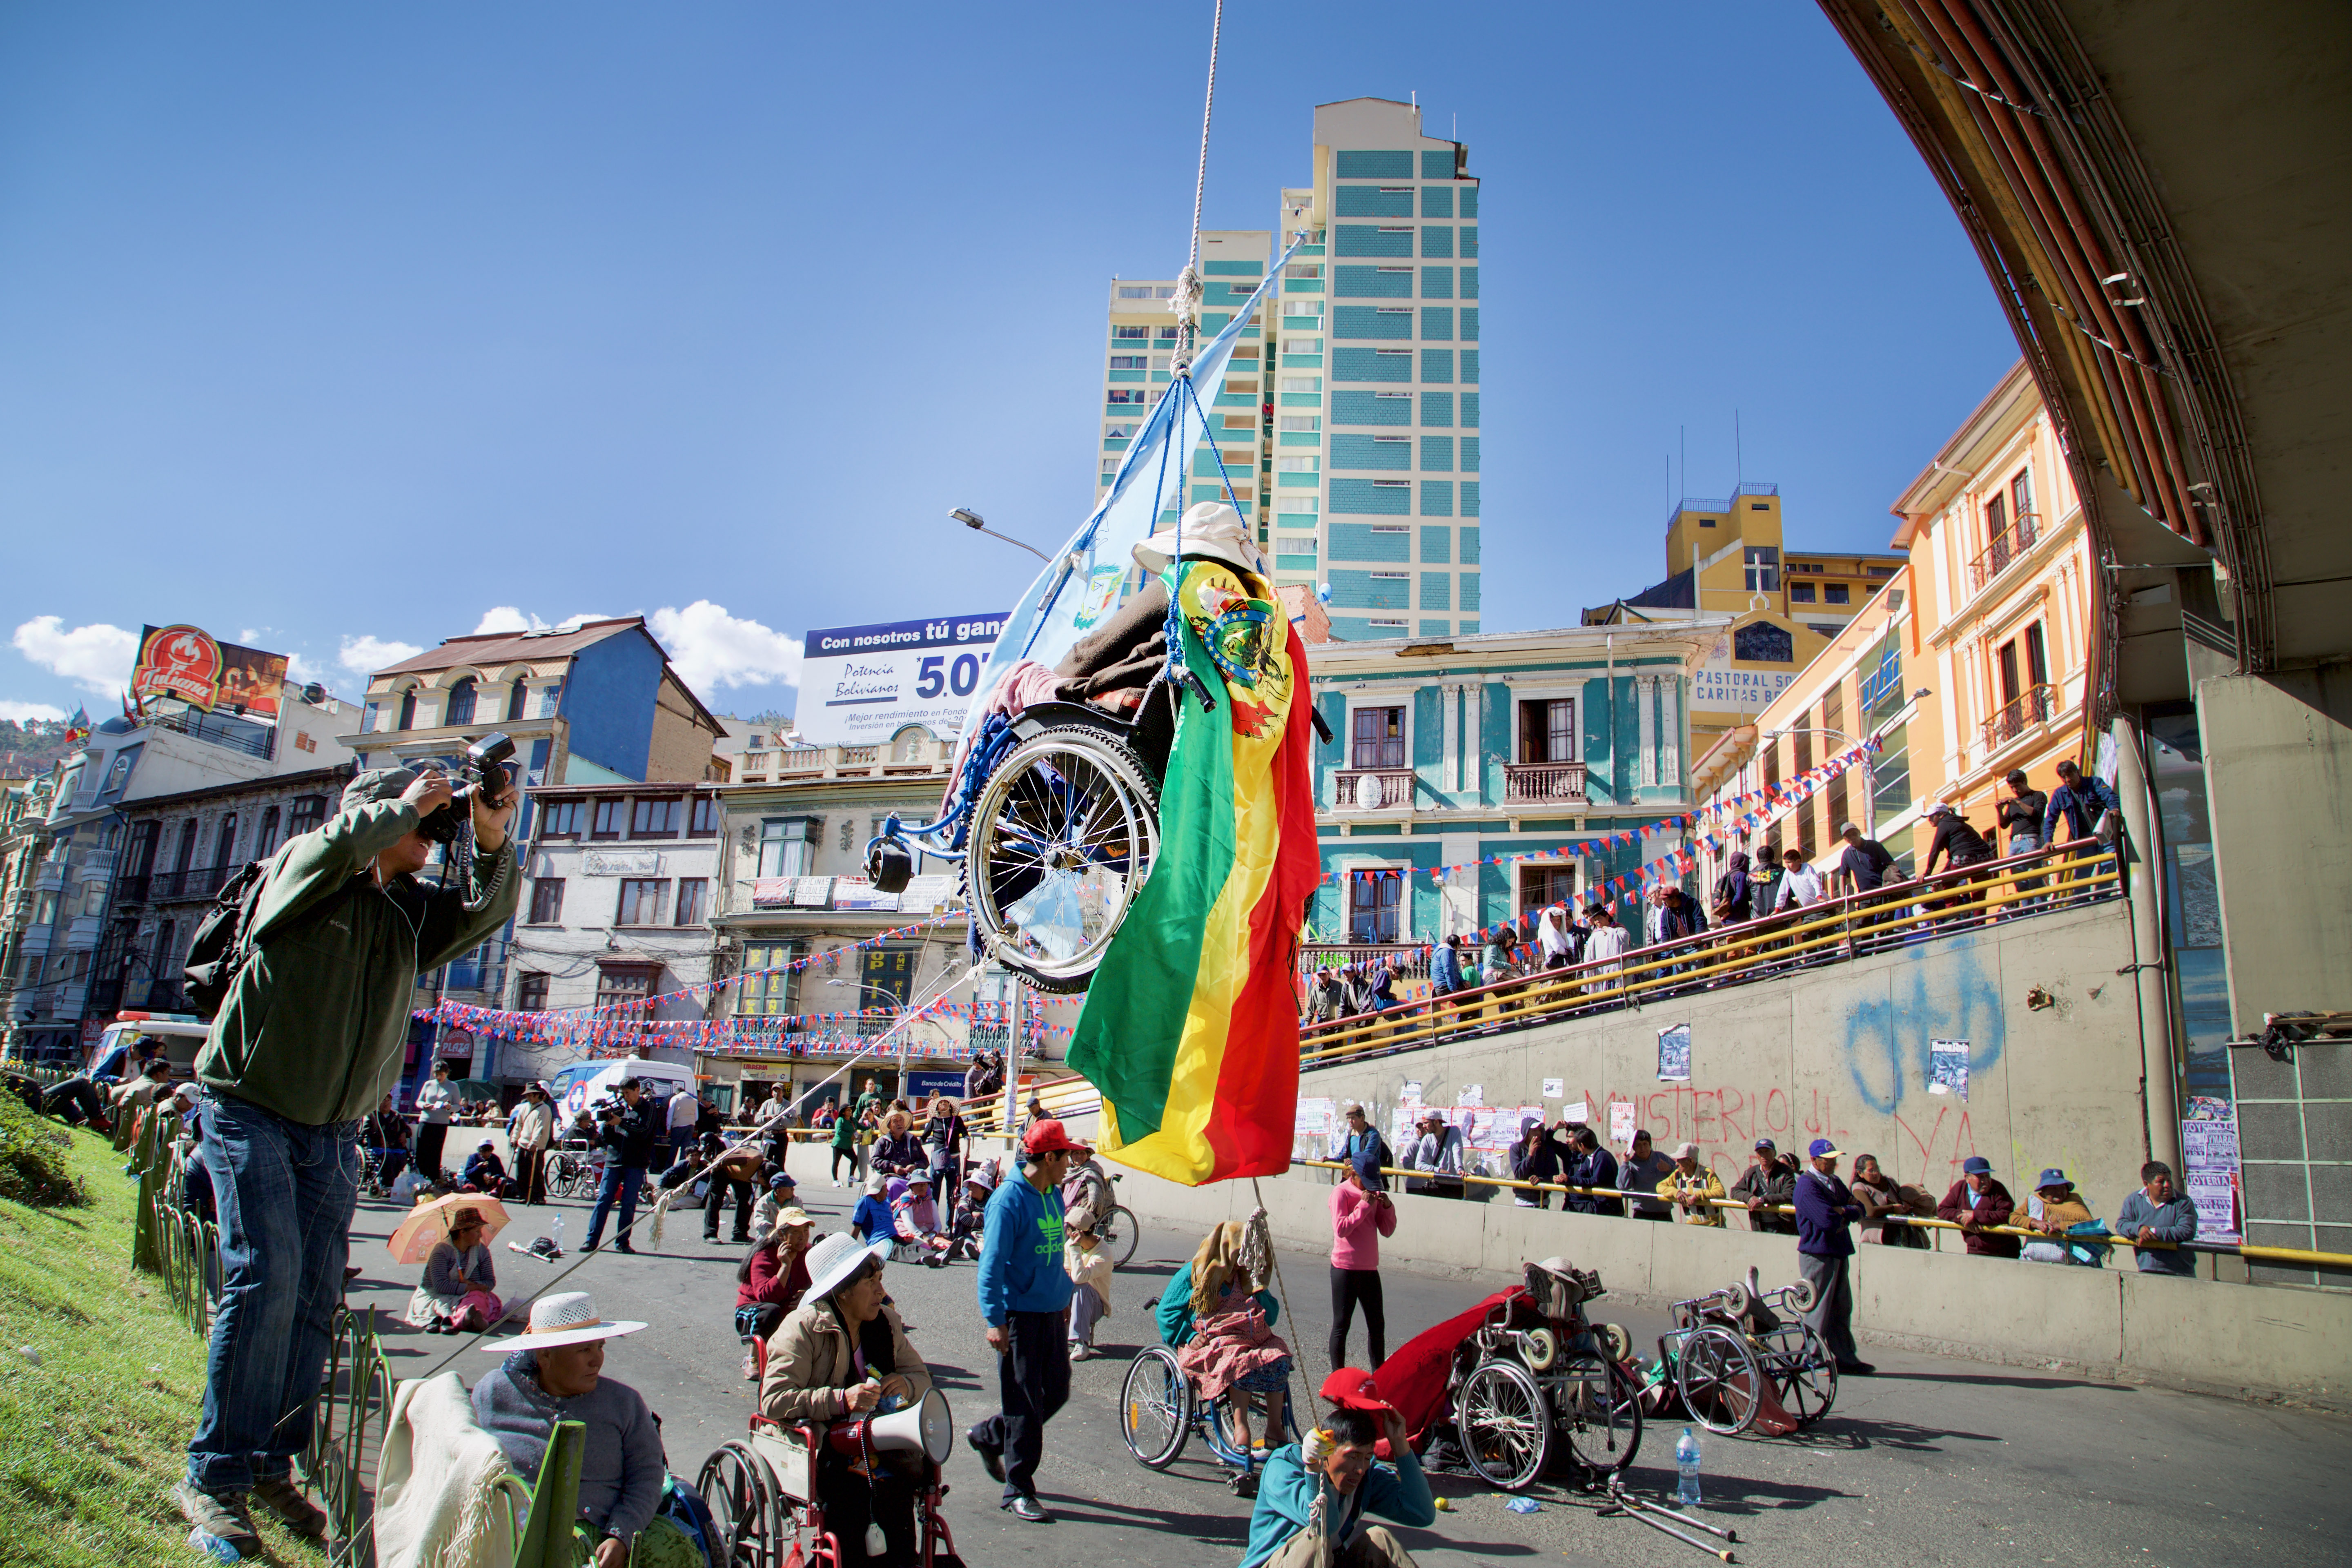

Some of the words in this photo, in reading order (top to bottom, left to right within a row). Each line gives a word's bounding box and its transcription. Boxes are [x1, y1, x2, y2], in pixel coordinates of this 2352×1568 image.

[821, 637, 850, 649] Con
[854, 631, 921, 646] nosotros
[926, 620, 949, 640] tú
[844, 663, 894, 679] Potencia
[136, 667, 212, 698] Juliana
[1697, 671, 1768, 687] PASTORAL
[1776, 675, 1797, 688] SO
[835, 681, 899, 697] Bolivianos
[1697, 687, 1757, 702] CARITAS
[844, 714, 873, 724] ¡Mejor
[875, 710, 928, 720] rendimiento
[849, 722, 882, 730] Inversión
[447, 1030, 469, 1042] HOSTAL
[442, 1042, 470, 1054] PLAZA
[1931, 1041, 1952, 1052] Barón
[1952, 1042, 1969, 1054] Rojo
[1612, 1104, 1633, 1112] JOYERIA
[2205, 1135, 2232, 1144] AYMARA
[2189, 1176, 2229, 1186] JOYERIA
